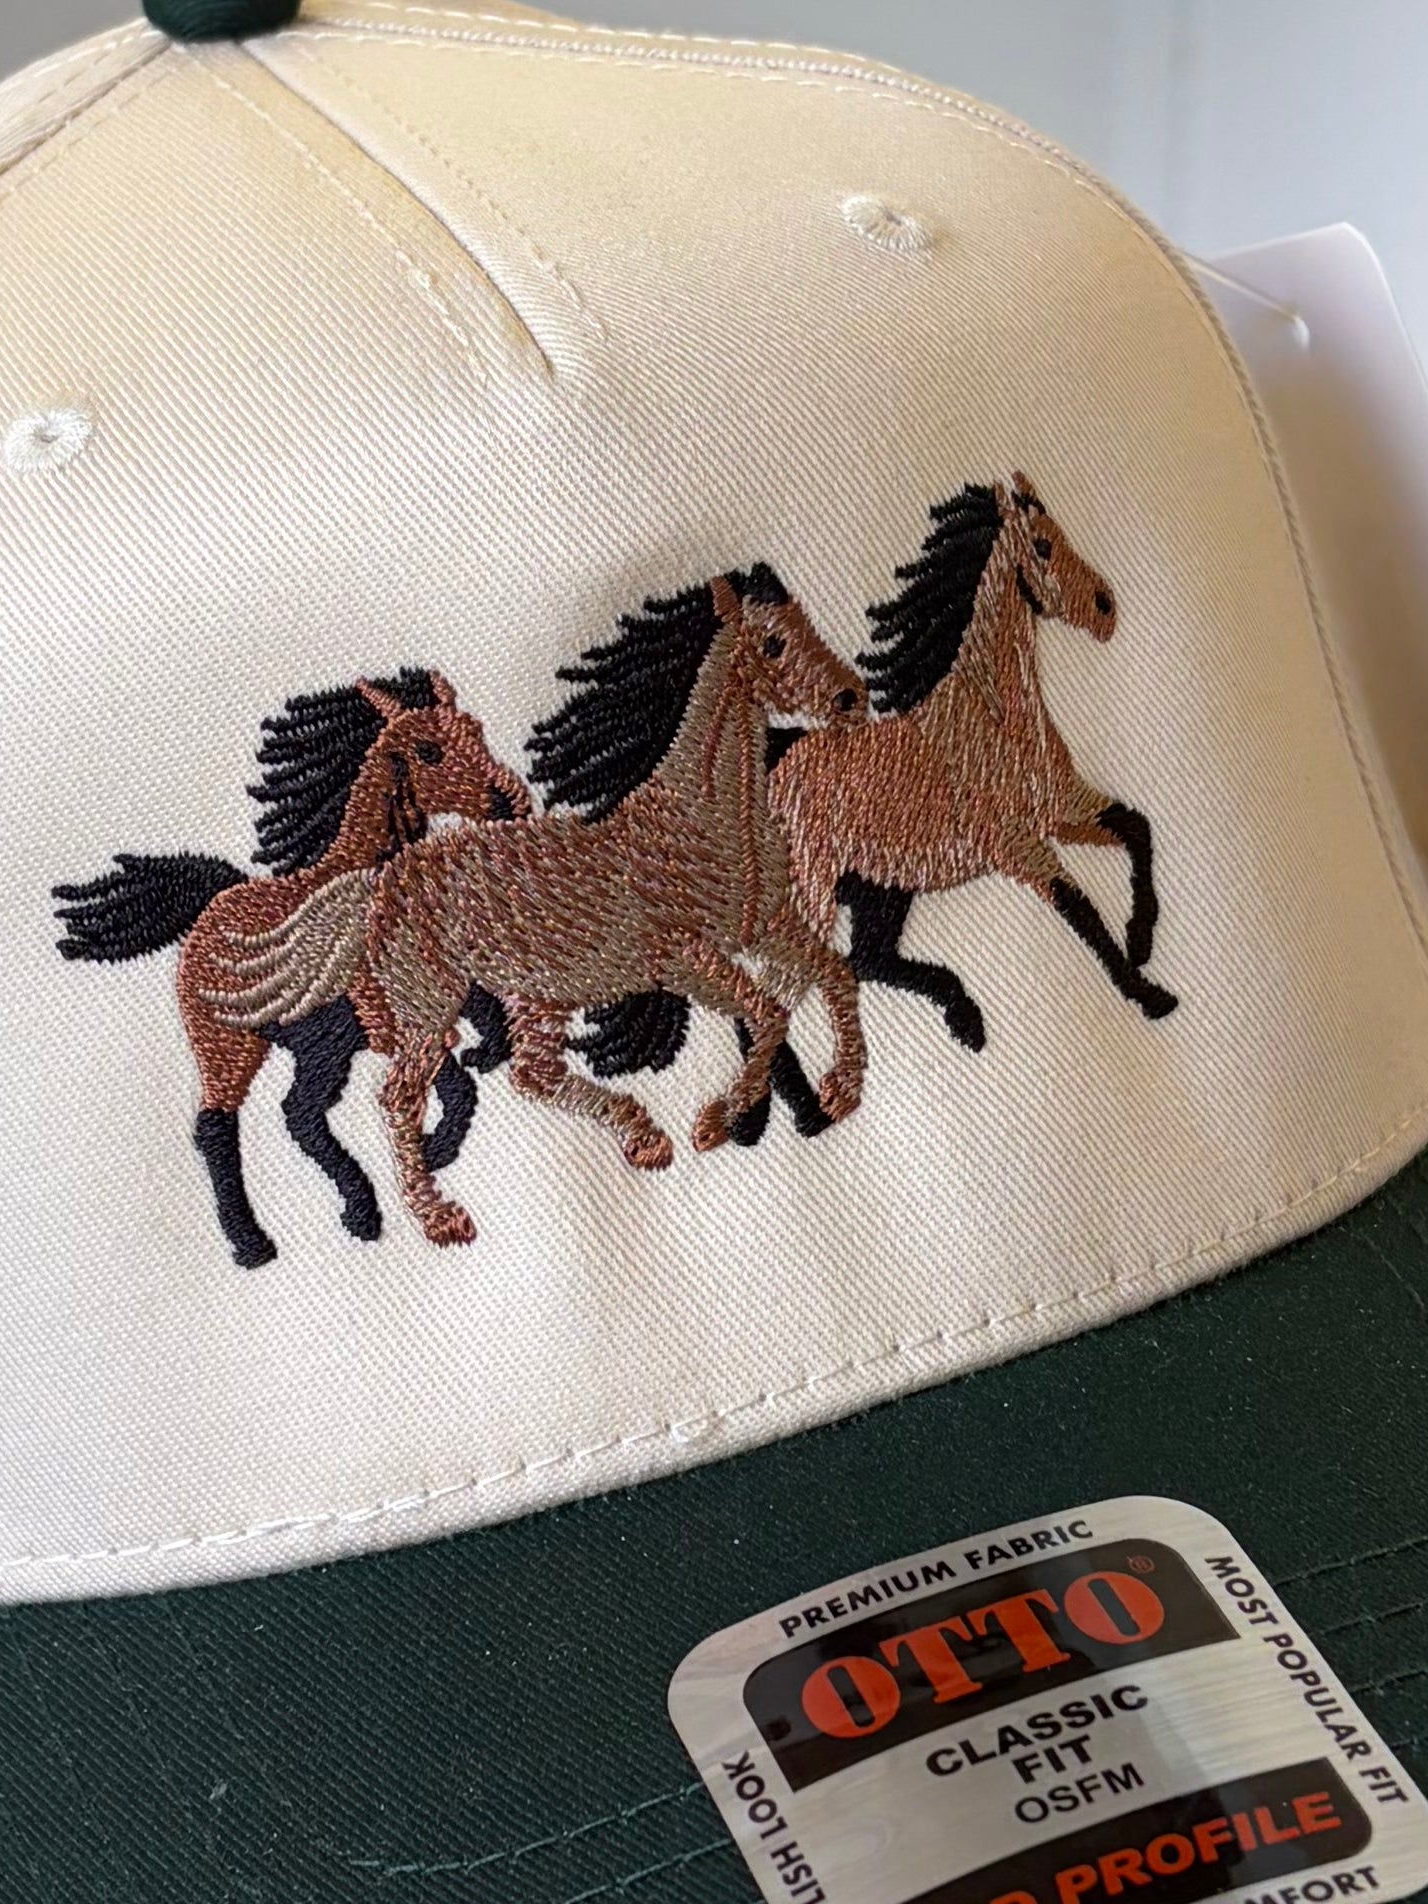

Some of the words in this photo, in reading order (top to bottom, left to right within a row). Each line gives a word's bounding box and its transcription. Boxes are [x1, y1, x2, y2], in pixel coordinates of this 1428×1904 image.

[778, 1560, 956, 1638] PREMIUM
[964, 1520, 1093, 1571] FABRIC
[801, 1571, 1164, 1739] OTTO
[1204, 1556, 1279, 1625] MOST
[1263, 1633, 1372, 1761] POPULAR
[1358, 1766, 1408, 1803] FIT
[926, 1685, 1148, 1776] CLASSIC
[1012, 1734, 1092, 1784] FIT
[722, 1750, 788, 1840] LOOK
[1015, 1763, 1144, 1823] OSFM
